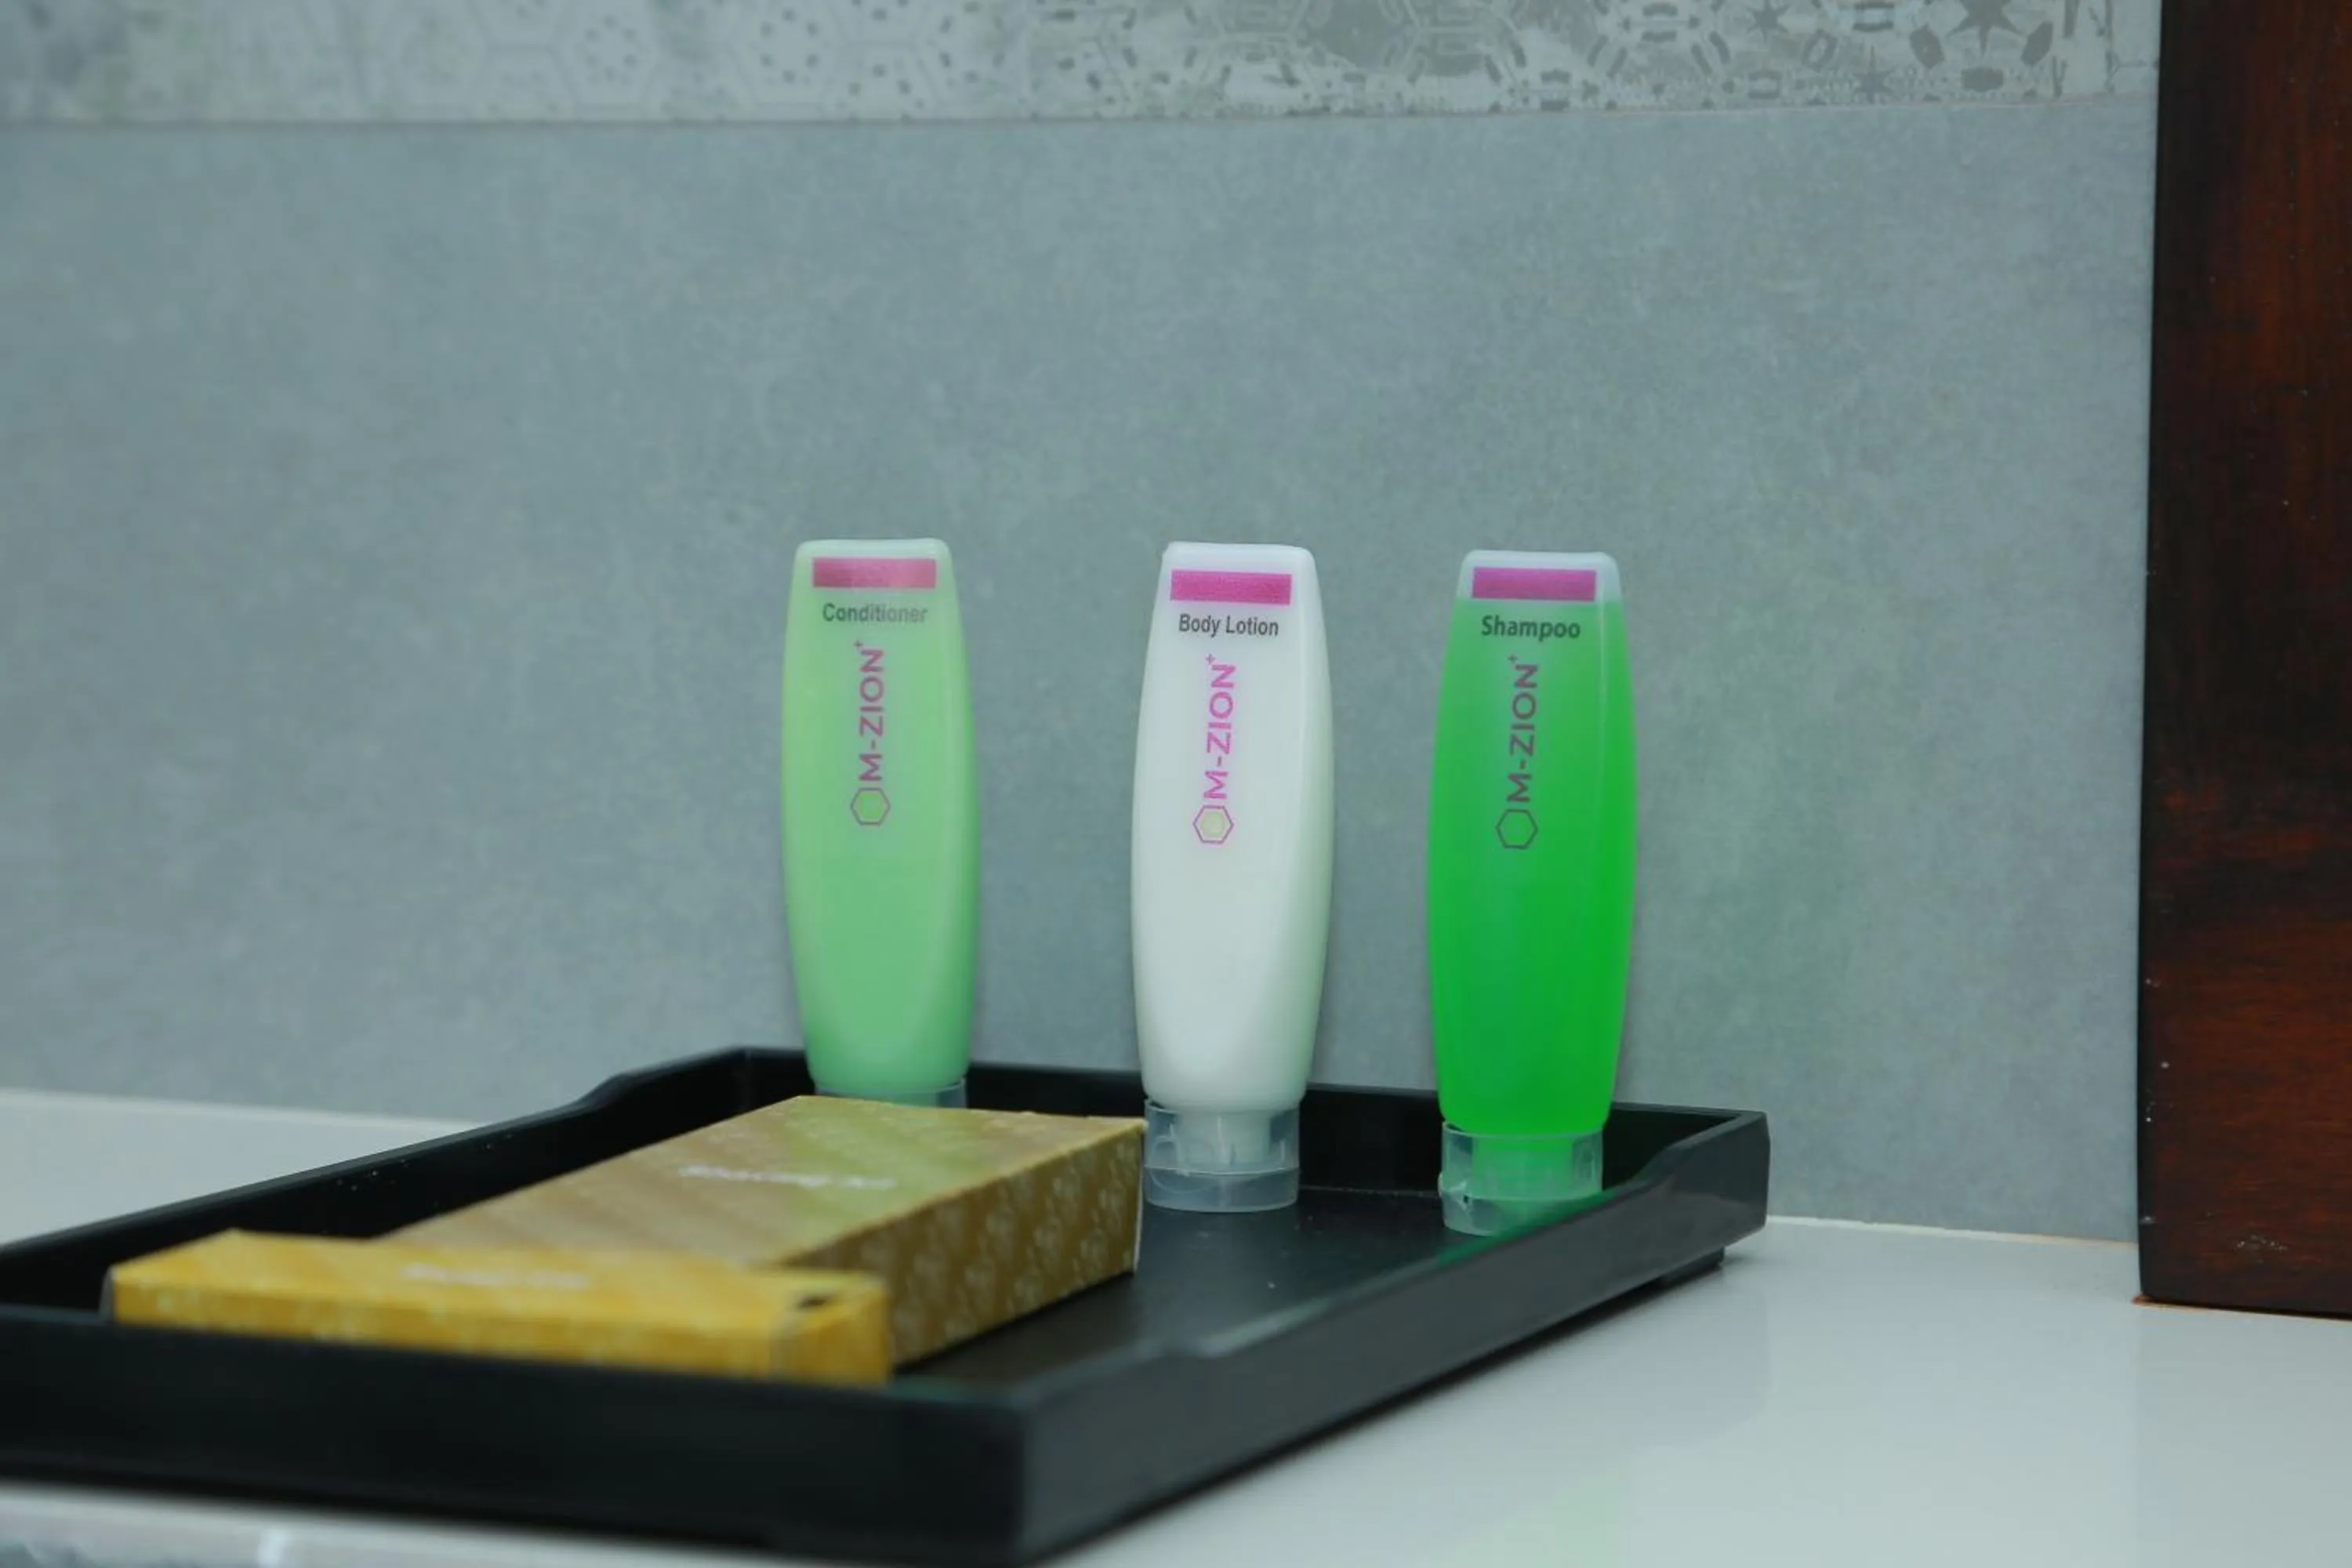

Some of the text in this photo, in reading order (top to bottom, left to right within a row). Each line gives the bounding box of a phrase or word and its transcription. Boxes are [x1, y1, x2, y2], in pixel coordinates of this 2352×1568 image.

[822, 602, 928, 623] Conditioner
[1178, 613, 1279, 637] Body Lotion
[1481, 615, 1581, 641] Shampoo
